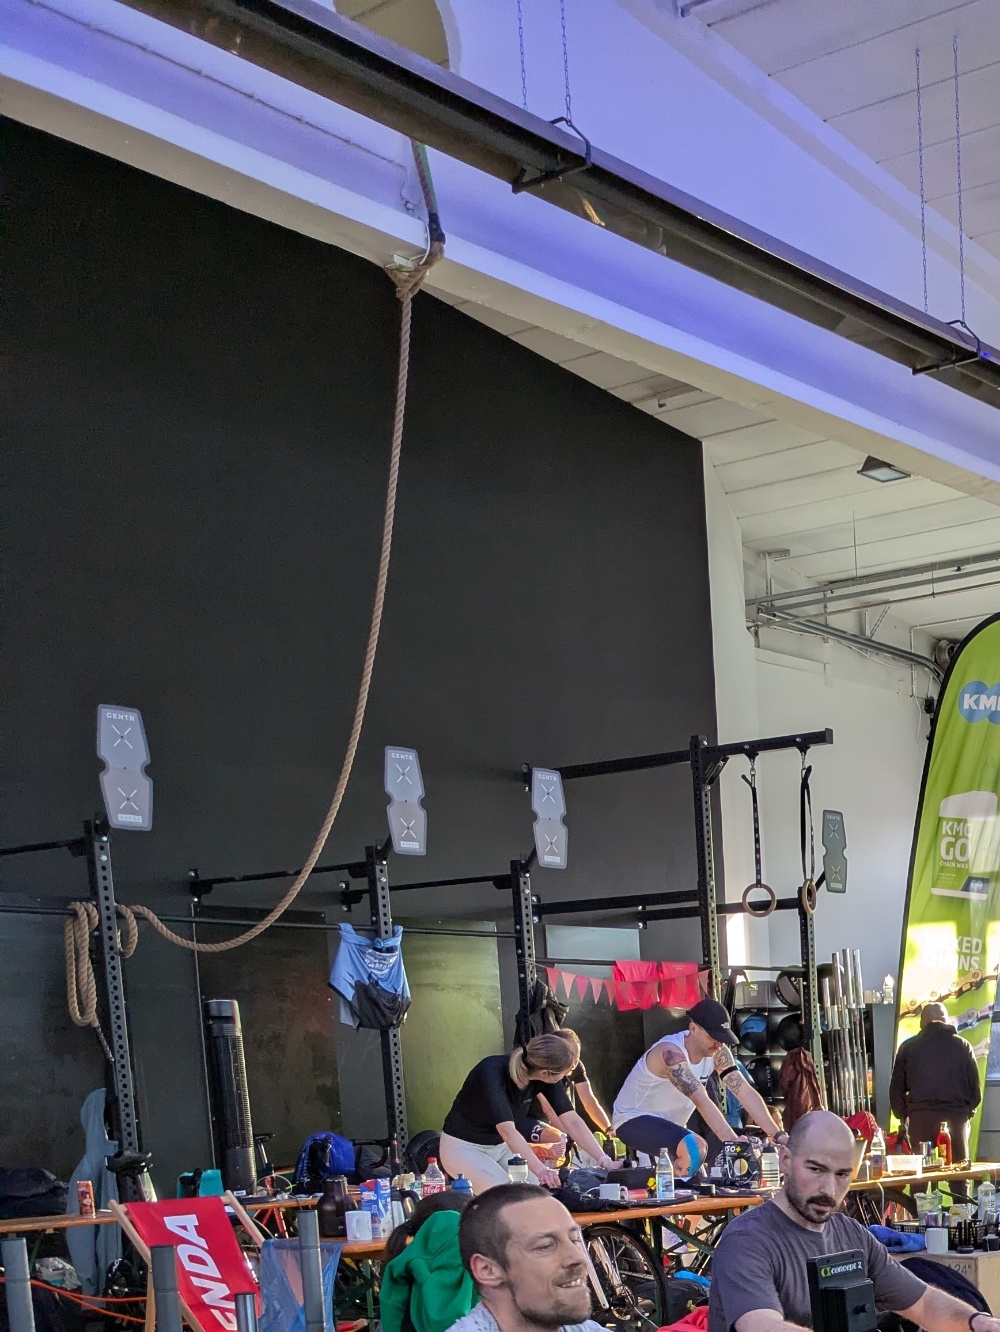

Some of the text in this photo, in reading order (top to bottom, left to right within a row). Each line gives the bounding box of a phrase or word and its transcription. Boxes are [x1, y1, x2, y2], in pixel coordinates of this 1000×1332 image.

[106, 712, 135, 721] CENTR
[391, 752, 413, 760] CENTR
[538, 773, 557, 781] CENTR
[940, 837, 972, 862] GO
[831, 1262, 857, 1275] concept
